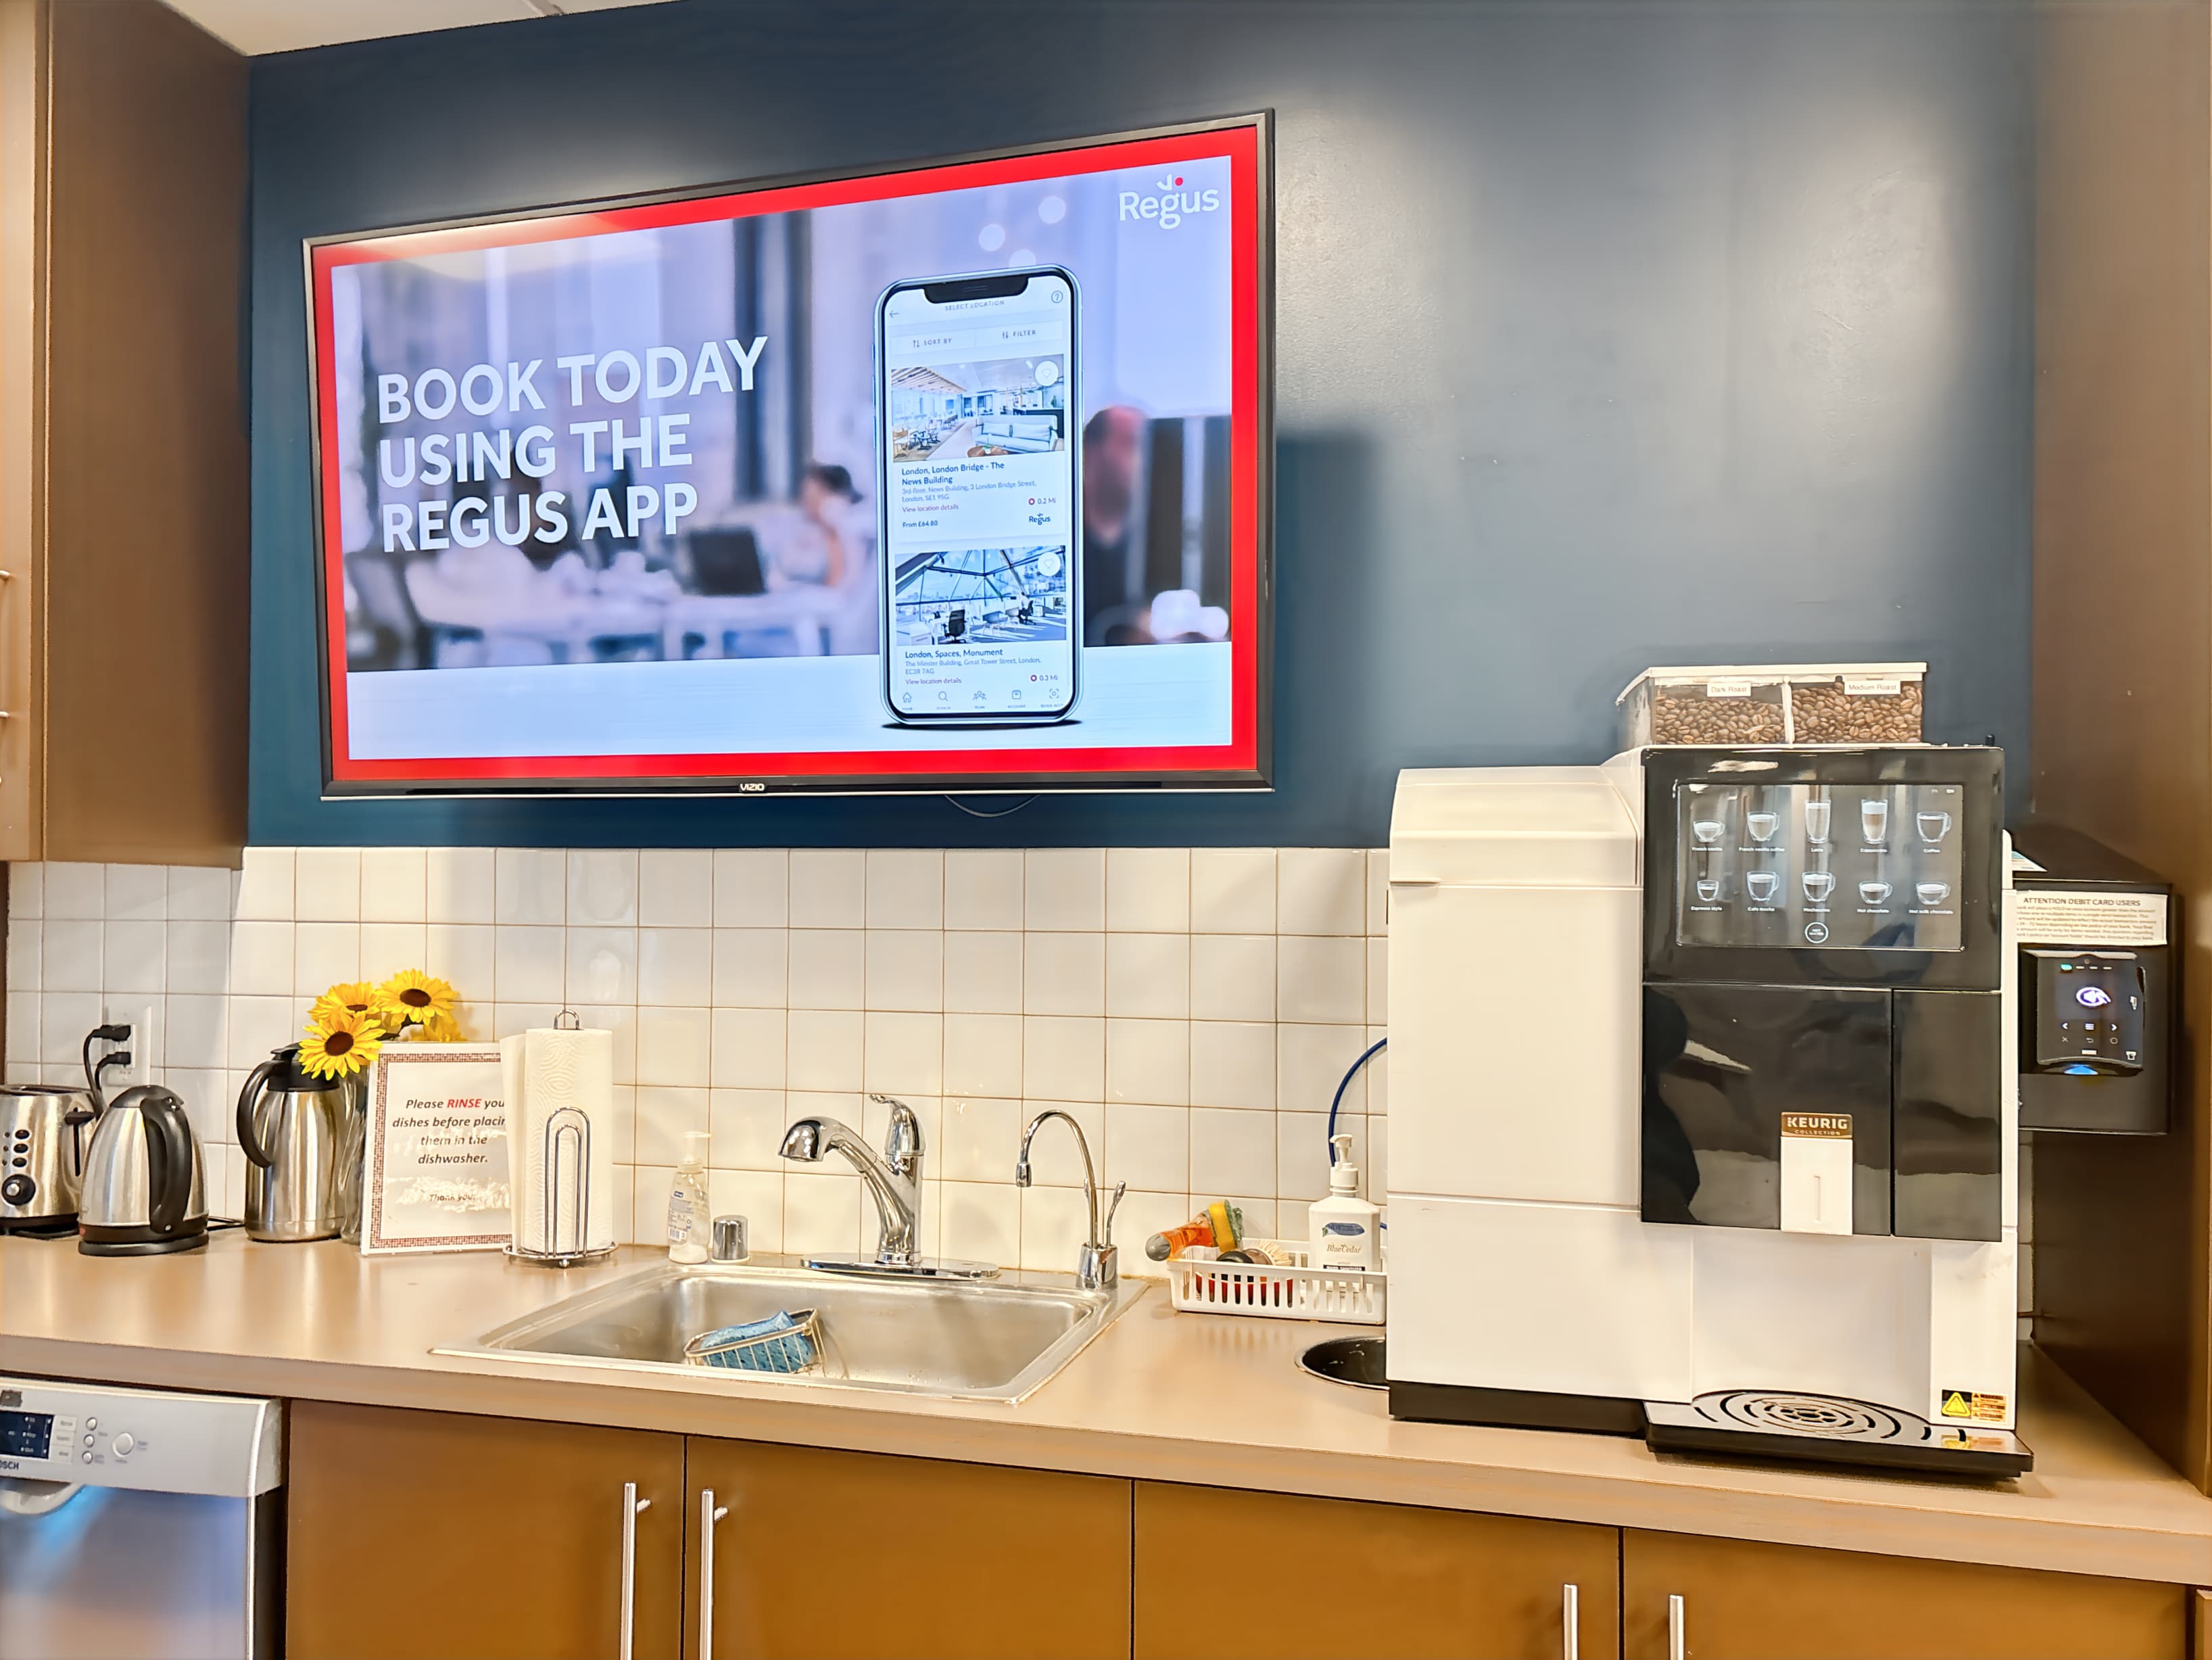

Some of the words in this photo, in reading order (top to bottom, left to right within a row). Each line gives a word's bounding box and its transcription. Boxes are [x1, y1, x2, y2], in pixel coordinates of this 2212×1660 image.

[1119, 188, 1220, 230] Regus
[944, 303, 968, 311] SELECT
[970, 300, 1005, 308] LOCATION
[378, 359, 546, 424] BOOK
[557, 336, 768, 406] TODAY
[379, 425, 556, 488] USING
[569, 413, 692, 473] THE
[901, 468, 930, 476] London,
[932, 465, 959, 473] London
[961, 464, 984, 472] Bridge
[923, 476, 953, 485] Building
[998, 481, 1016, 489] Bridge
[383, 491, 568, 552] REGUS
[581, 483, 698, 540] APP
[1029, 515, 1051, 525] Regus
[740, 783, 765, 792] VIZIO
[406, 1099, 443, 1109] Please
[447, 1099, 482, 1108] RINSE
[484, 1101, 505, 1110] you
[392, 1117, 429, 1128] dishes
[432, 1117, 471, 1129] before
[1787, 1116, 1848, 1130] KEURIG
[420, 1136, 451, 1145] them
[454, 1136, 465, 1145] in
[468, 1135, 487, 1145] the
[418, 1153, 488, 1164] dishwasher.
